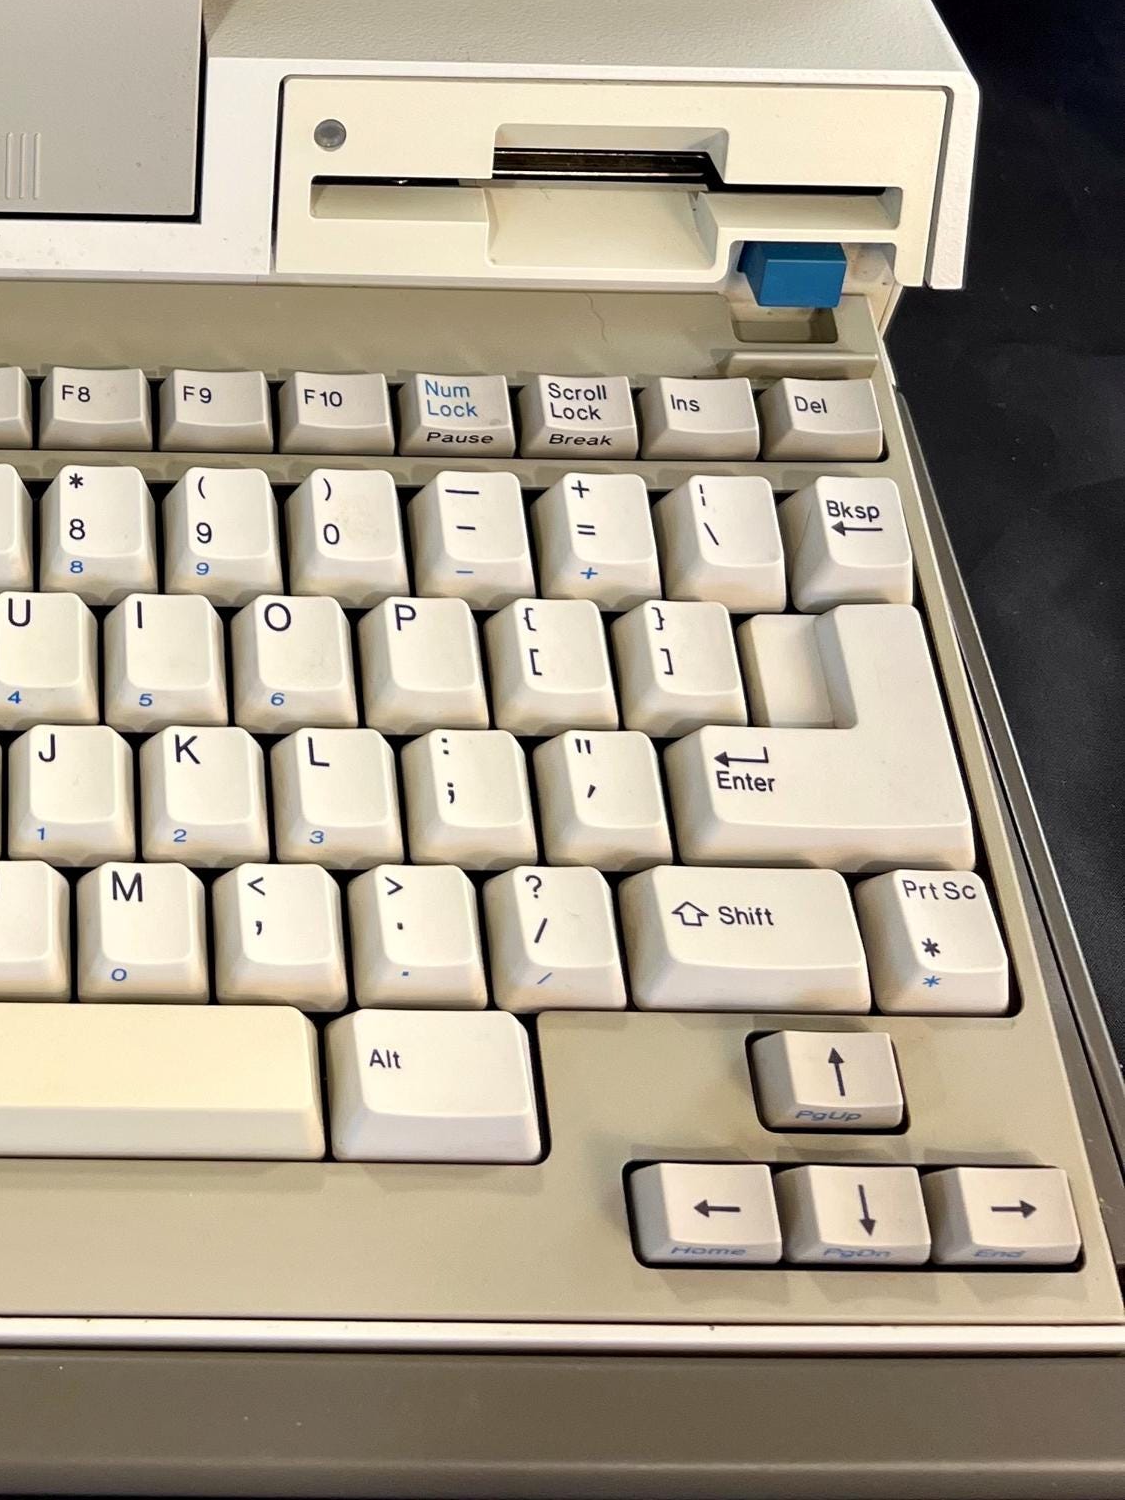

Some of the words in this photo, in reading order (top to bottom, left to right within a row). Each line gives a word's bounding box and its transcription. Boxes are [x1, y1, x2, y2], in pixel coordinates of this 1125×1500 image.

[63, 385, 90, 402] F8
[184, 386, 211, 403] F9
[425, 380, 470, 397] Num
[549, 383, 606, 401] Scroll
[305, 389, 342, 407] F10
[671, 395, 700, 412] Ins
[795, 396, 827, 413] Del
[427, 400, 478, 417] Lock
[551, 403, 601, 420] Lock
[427, 432, 493, 443] Pause
[549, 434, 611, 445] Break
[197, 476, 206, 499] (
[323, 478, 332, 501] )
[827, 500, 879, 522] Bksp
[70, 519, 85, 540] 8
[197, 523, 212, 543] 9
[324, 524, 339, 544] 0
[577, 525, 595, 535] =
[70, 561, 83, 573] 8
[197, 563, 209, 575] 9
[8, 598, 30, 627] U
[264, 603, 291, 631] O
[395, 604, 416, 631] P
[524, 608, 536, 631] {
[652, 607, 664, 630] }
[530, 649, 542, 676] [
[661, 648, 673, 675] ]
[8, 691, 21, 703] 4
[139, 694, 152, 706] 5
[271, 693, 284, 706] 6
[39, 734, 55, 762] J
[175, 735, 200, 764] K
[308, 737, 329, 767] L
[441, 738, 450, 754] :
[717, 771, 775, 792] Enter
[447, 783, 455, 803] ;
[37, 828, 45, 840] 1
[174, 829, 186, 842] 2
[310, 831, 324, 844] 3
[112, 871, 142, 902] M
[248, 877, 265, 895] <
[386, 877, 403, 895] >
[526, 875, 542, 898] ?
[719, 906, 774, 925] Shift
[534, 918, 547, 943] /
[537, 973, 552, 984] /
[370, 1049, 400, 1068] Alt
[796, 1111, 861, 1121] PgUp
[671, 1246, 745, 1256] Home
[824, 1249, 889, 1258] PgDn
[971, 1247, 1024, 1259] End
